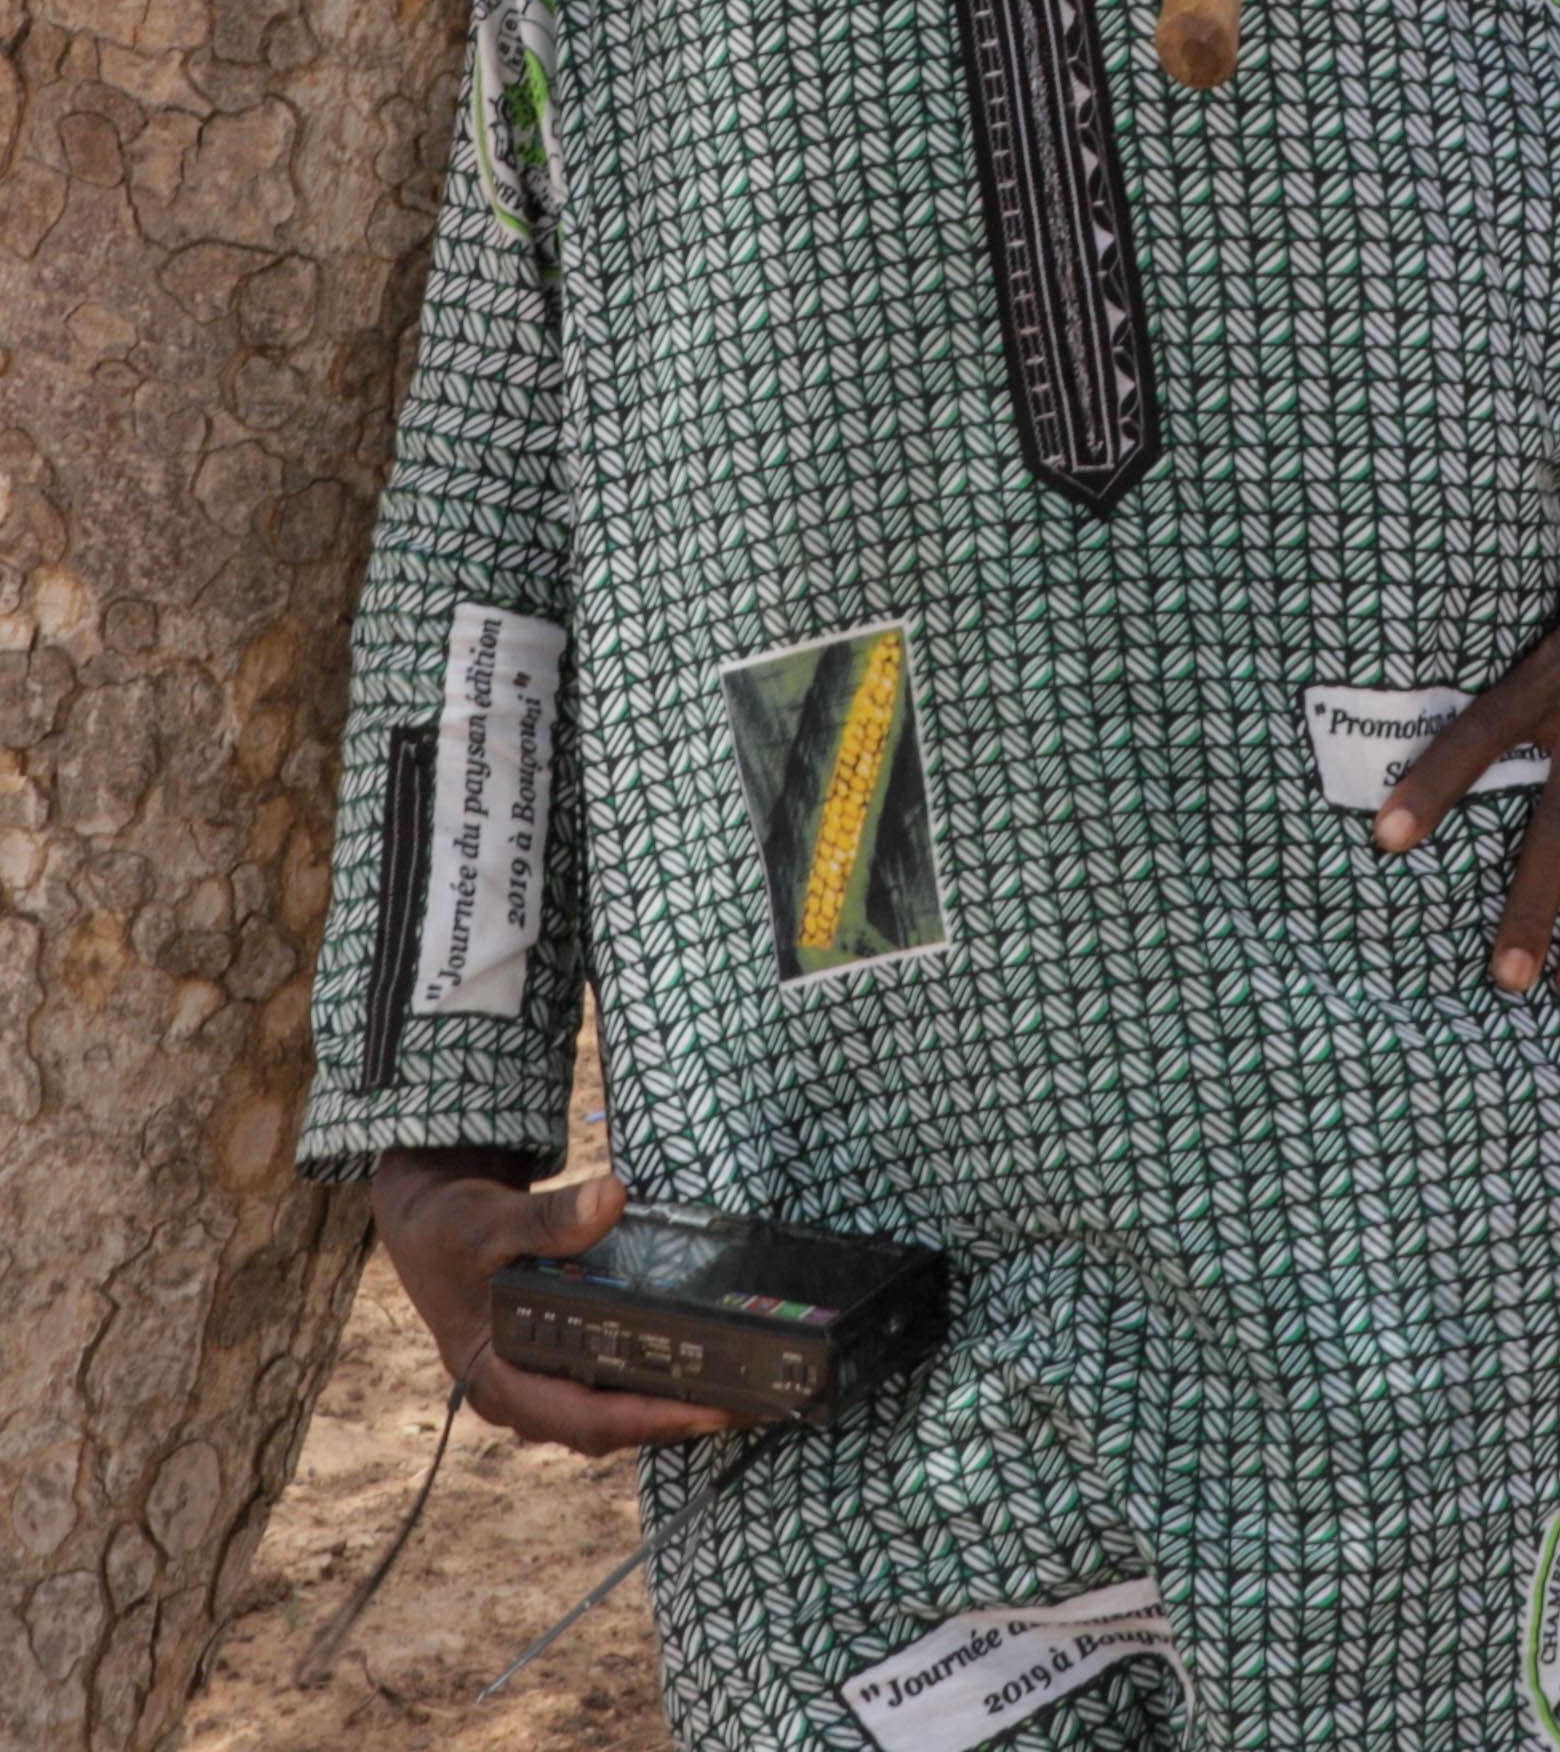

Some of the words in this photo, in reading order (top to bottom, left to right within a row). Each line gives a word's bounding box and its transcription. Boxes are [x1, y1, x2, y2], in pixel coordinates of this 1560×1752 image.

[465, 617, 503, 707] édition
[464, 712, 493, 818] paysan
[453, 821, 483, 863] du
[507, 828, 536, 852] à
[507, 858, 533, 930] 2019
[983, 1664, 1052, 1715] 2019
[1049, 1646, 1075, 1673] à
